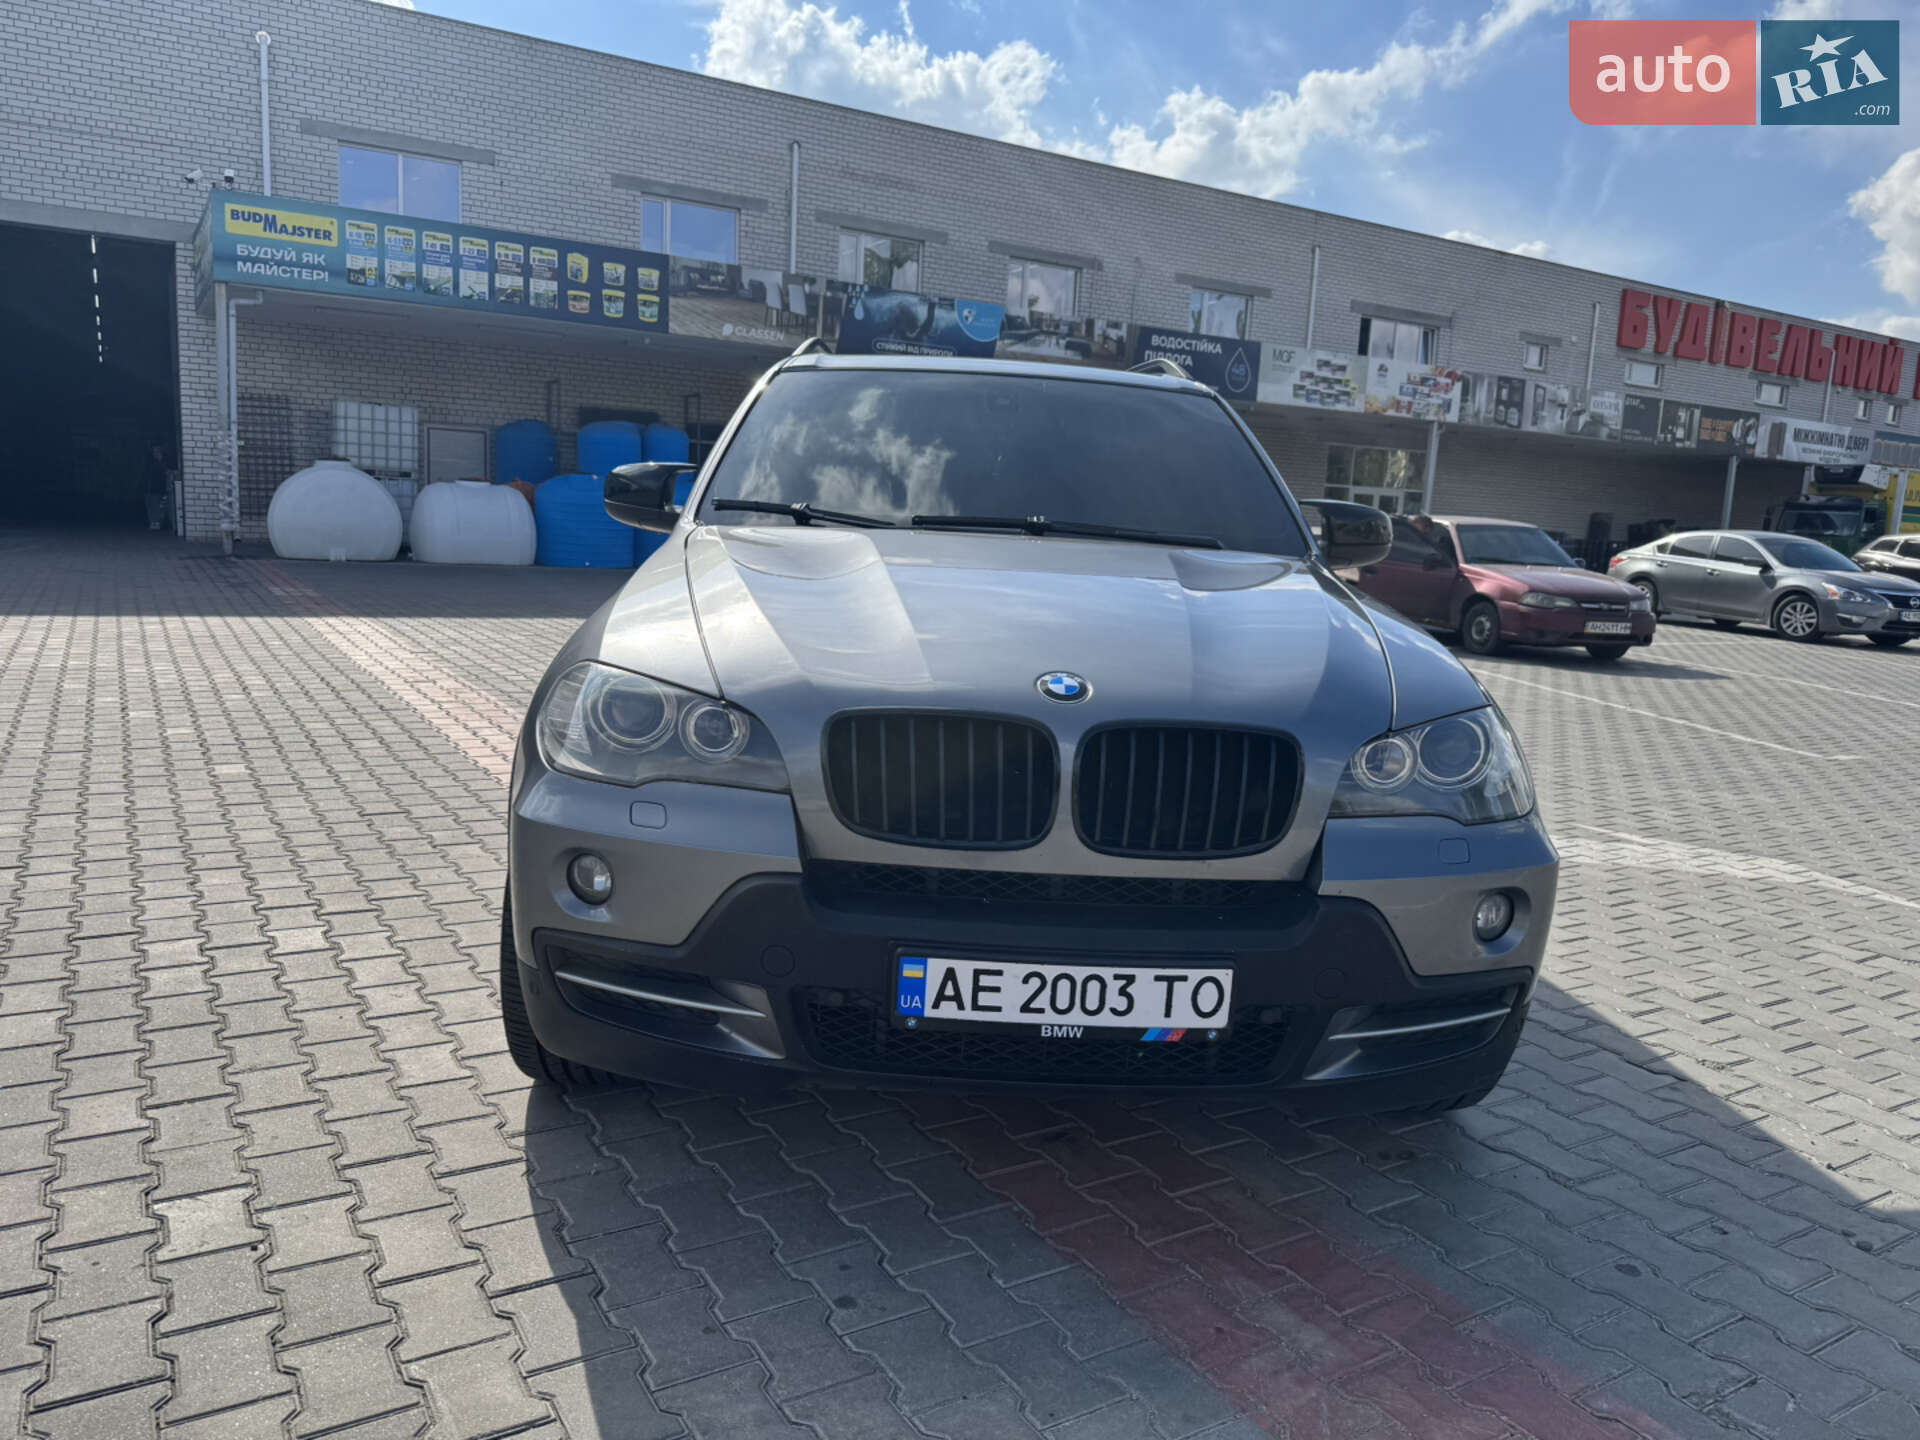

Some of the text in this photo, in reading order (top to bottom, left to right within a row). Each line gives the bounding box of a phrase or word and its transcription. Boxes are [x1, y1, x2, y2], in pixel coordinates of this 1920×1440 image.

[236, 244, 326, 266] БУДУЙ ЯК
[735, 326, 785, 341] CLASSEN
[1616, 287, 1904, 395] БУДІВЕЛЬНИЙ
[1151, 334, 1222, 355] ВОДОСТІЙКА
[1272, 348, 1297, 363] MGF
[900, 995, 923, 1009] UA
[931, 967, 1225, 1019] AE 2003 TO
[1041, 1024, 1084, 1039] BMW
